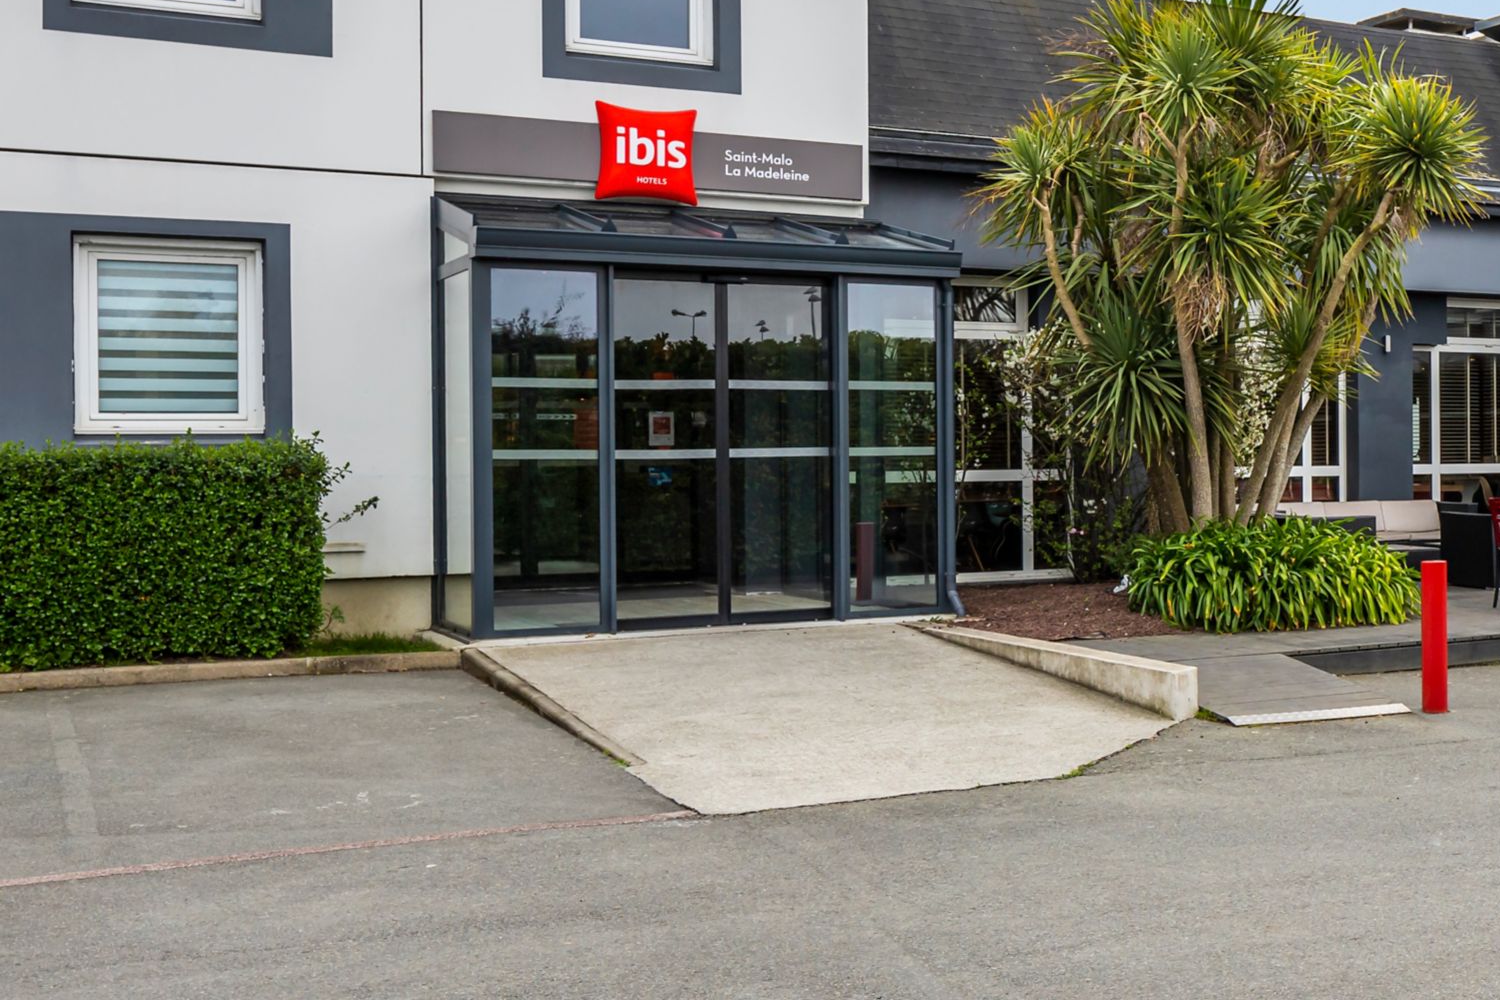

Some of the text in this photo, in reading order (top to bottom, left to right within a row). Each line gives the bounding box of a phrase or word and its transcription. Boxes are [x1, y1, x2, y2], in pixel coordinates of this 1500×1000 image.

[616, 125, 687, 169] ibis
[724, 149, 793, 166] Saint-Malo
[636, 176, 667, 185] HOTELS
[724, 164, 810, 182] La Madeleine
